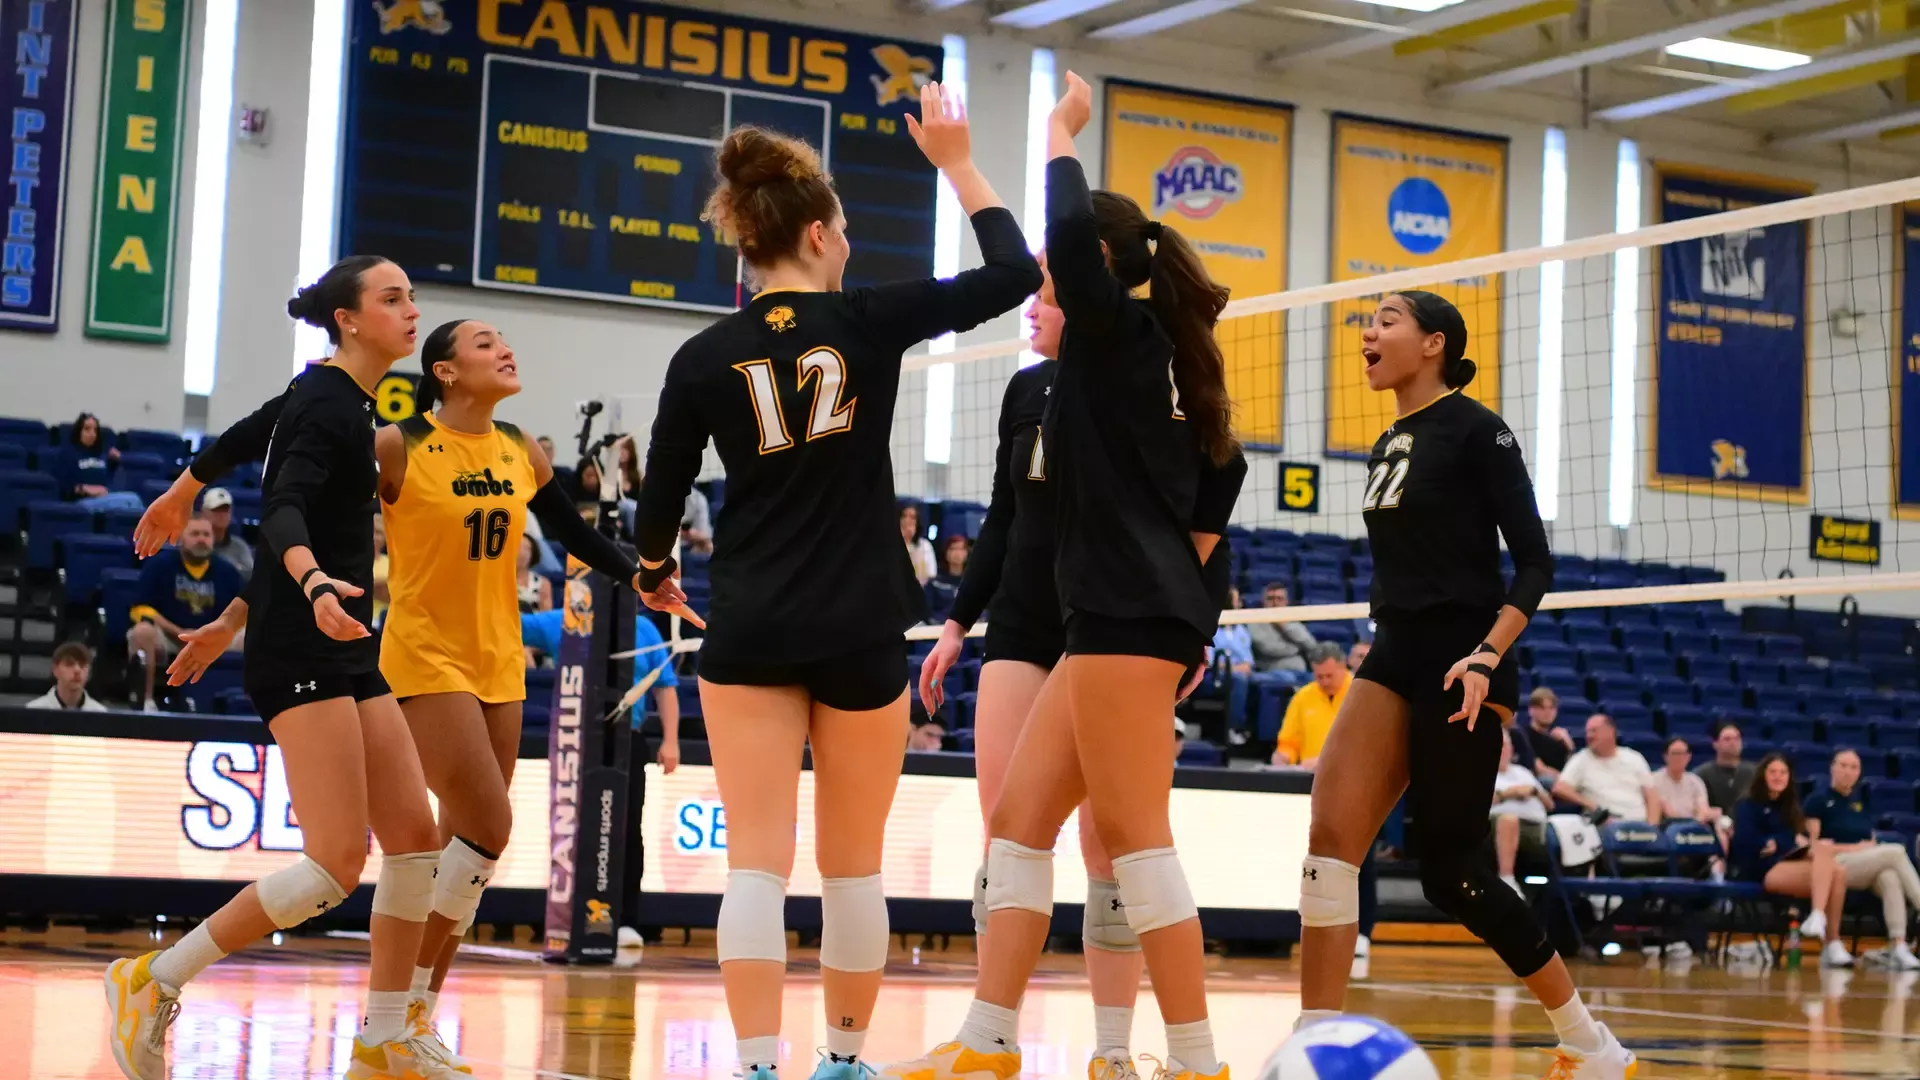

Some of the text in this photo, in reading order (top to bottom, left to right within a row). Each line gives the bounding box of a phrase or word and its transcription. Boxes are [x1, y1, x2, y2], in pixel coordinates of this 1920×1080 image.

[477, 0, 848, 94] CANISIUS
[110, 0, 167, 274] SIENA
[498, 120, 588, 152] CANISIUS
[2, 107, 46, 307] PETERS
[1154, 163, 1241, 210] MAAC
[498, 203, 541, 223] FOULS
[610, 215, 661, 237] PLAYER
[1393, 210, 1450, 239] NCAA
[376, 376, 416, 423] 6
[731, 345, 858, 455] 12
[451, 467, 515, 496] umbc
[1283, 467, 1315, 508] 5
[1362, 458, 1410, 513] 22
[464, 508, 511, 561] 16
[551, 665, 584, 904] CANISIUS
[597, 789, 614, 892] sports imports
[841, 1016, 854, 1027] 12
